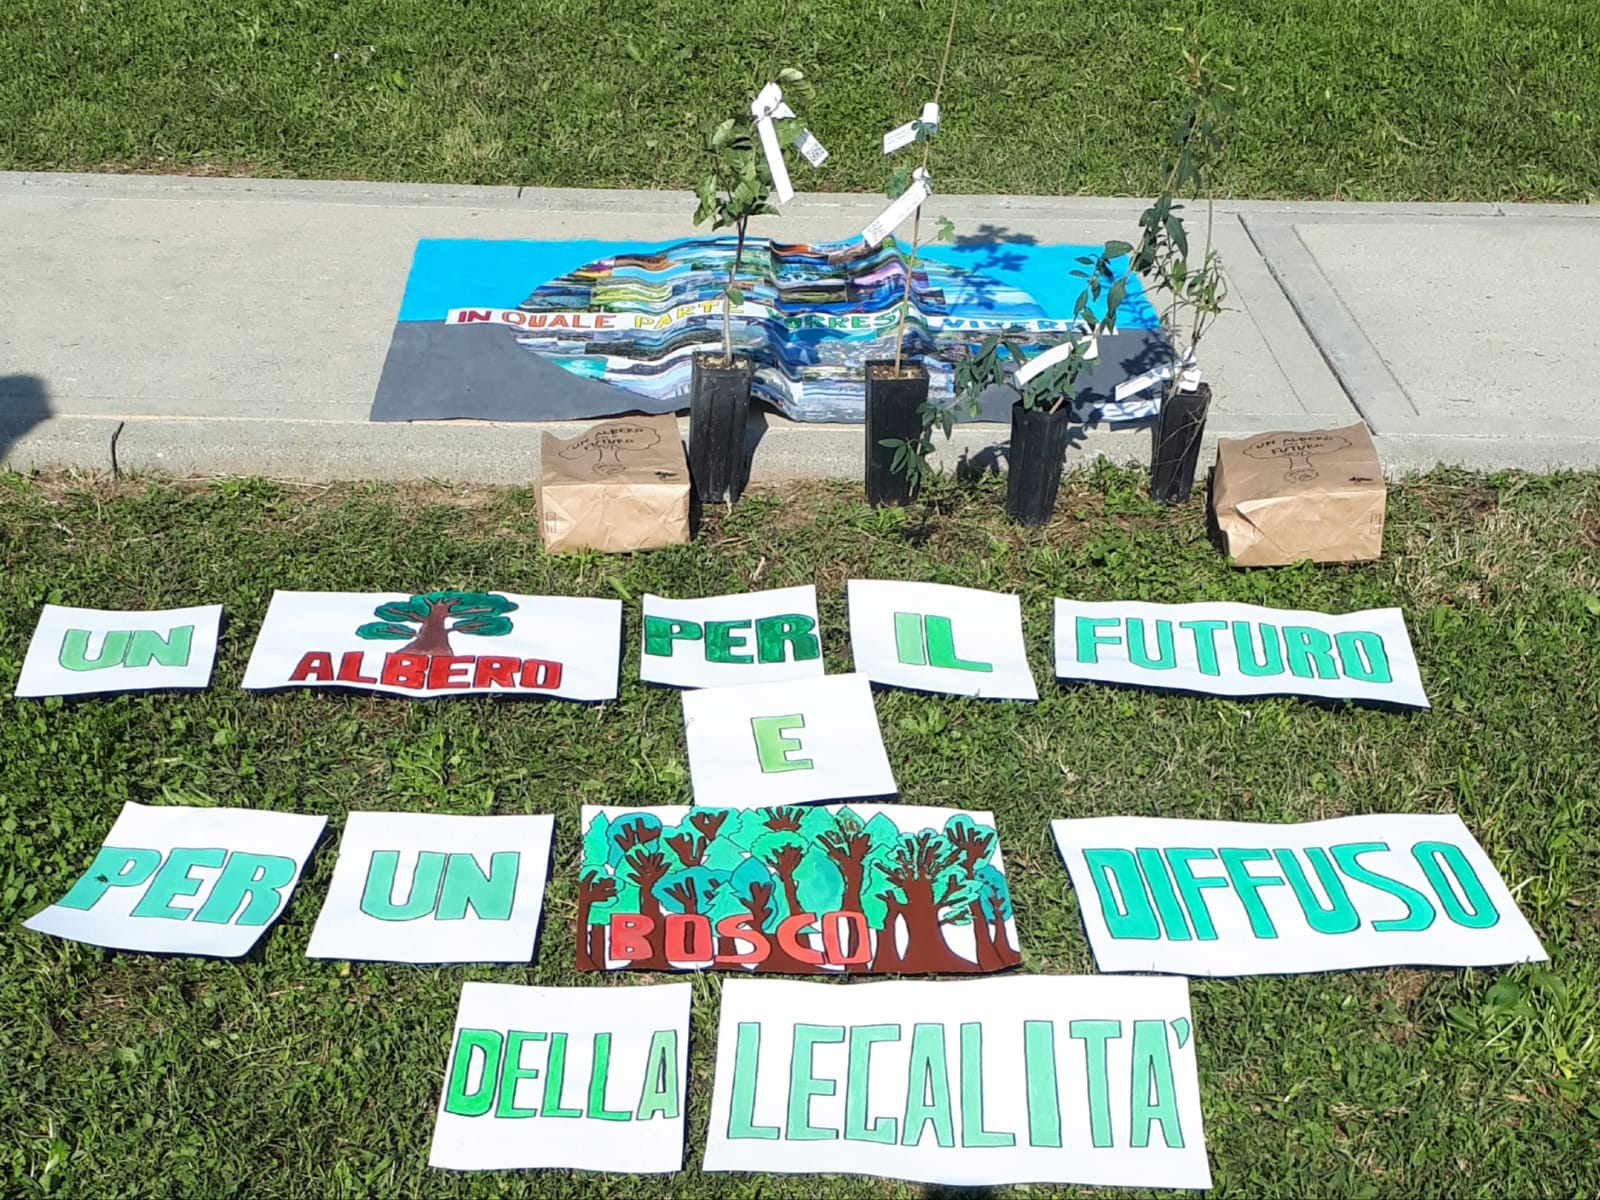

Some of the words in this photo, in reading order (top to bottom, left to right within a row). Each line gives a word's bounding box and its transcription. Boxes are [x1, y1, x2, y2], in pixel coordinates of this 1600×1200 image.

[458, 310, 492, 323] IN
[501, 311, 617, 329] QUALE
[59, 625, 194, 672] UN
[644, 613, 820, 664] PER
[894, 612, 993, 672] IL
[1076, 616, 1393, 683] FUTURO
[289, 651, 563, 690] ALBERO
[750, 713, 815, 773] E
[54, 846, 297, 926] PER
[360, 850, 520, 921] UN
[1082, 840, 1500, 941] DIFFUSO
[609, 911, 872, 965] BOSCO
[444, 1028, 680, 1121] DELLA
